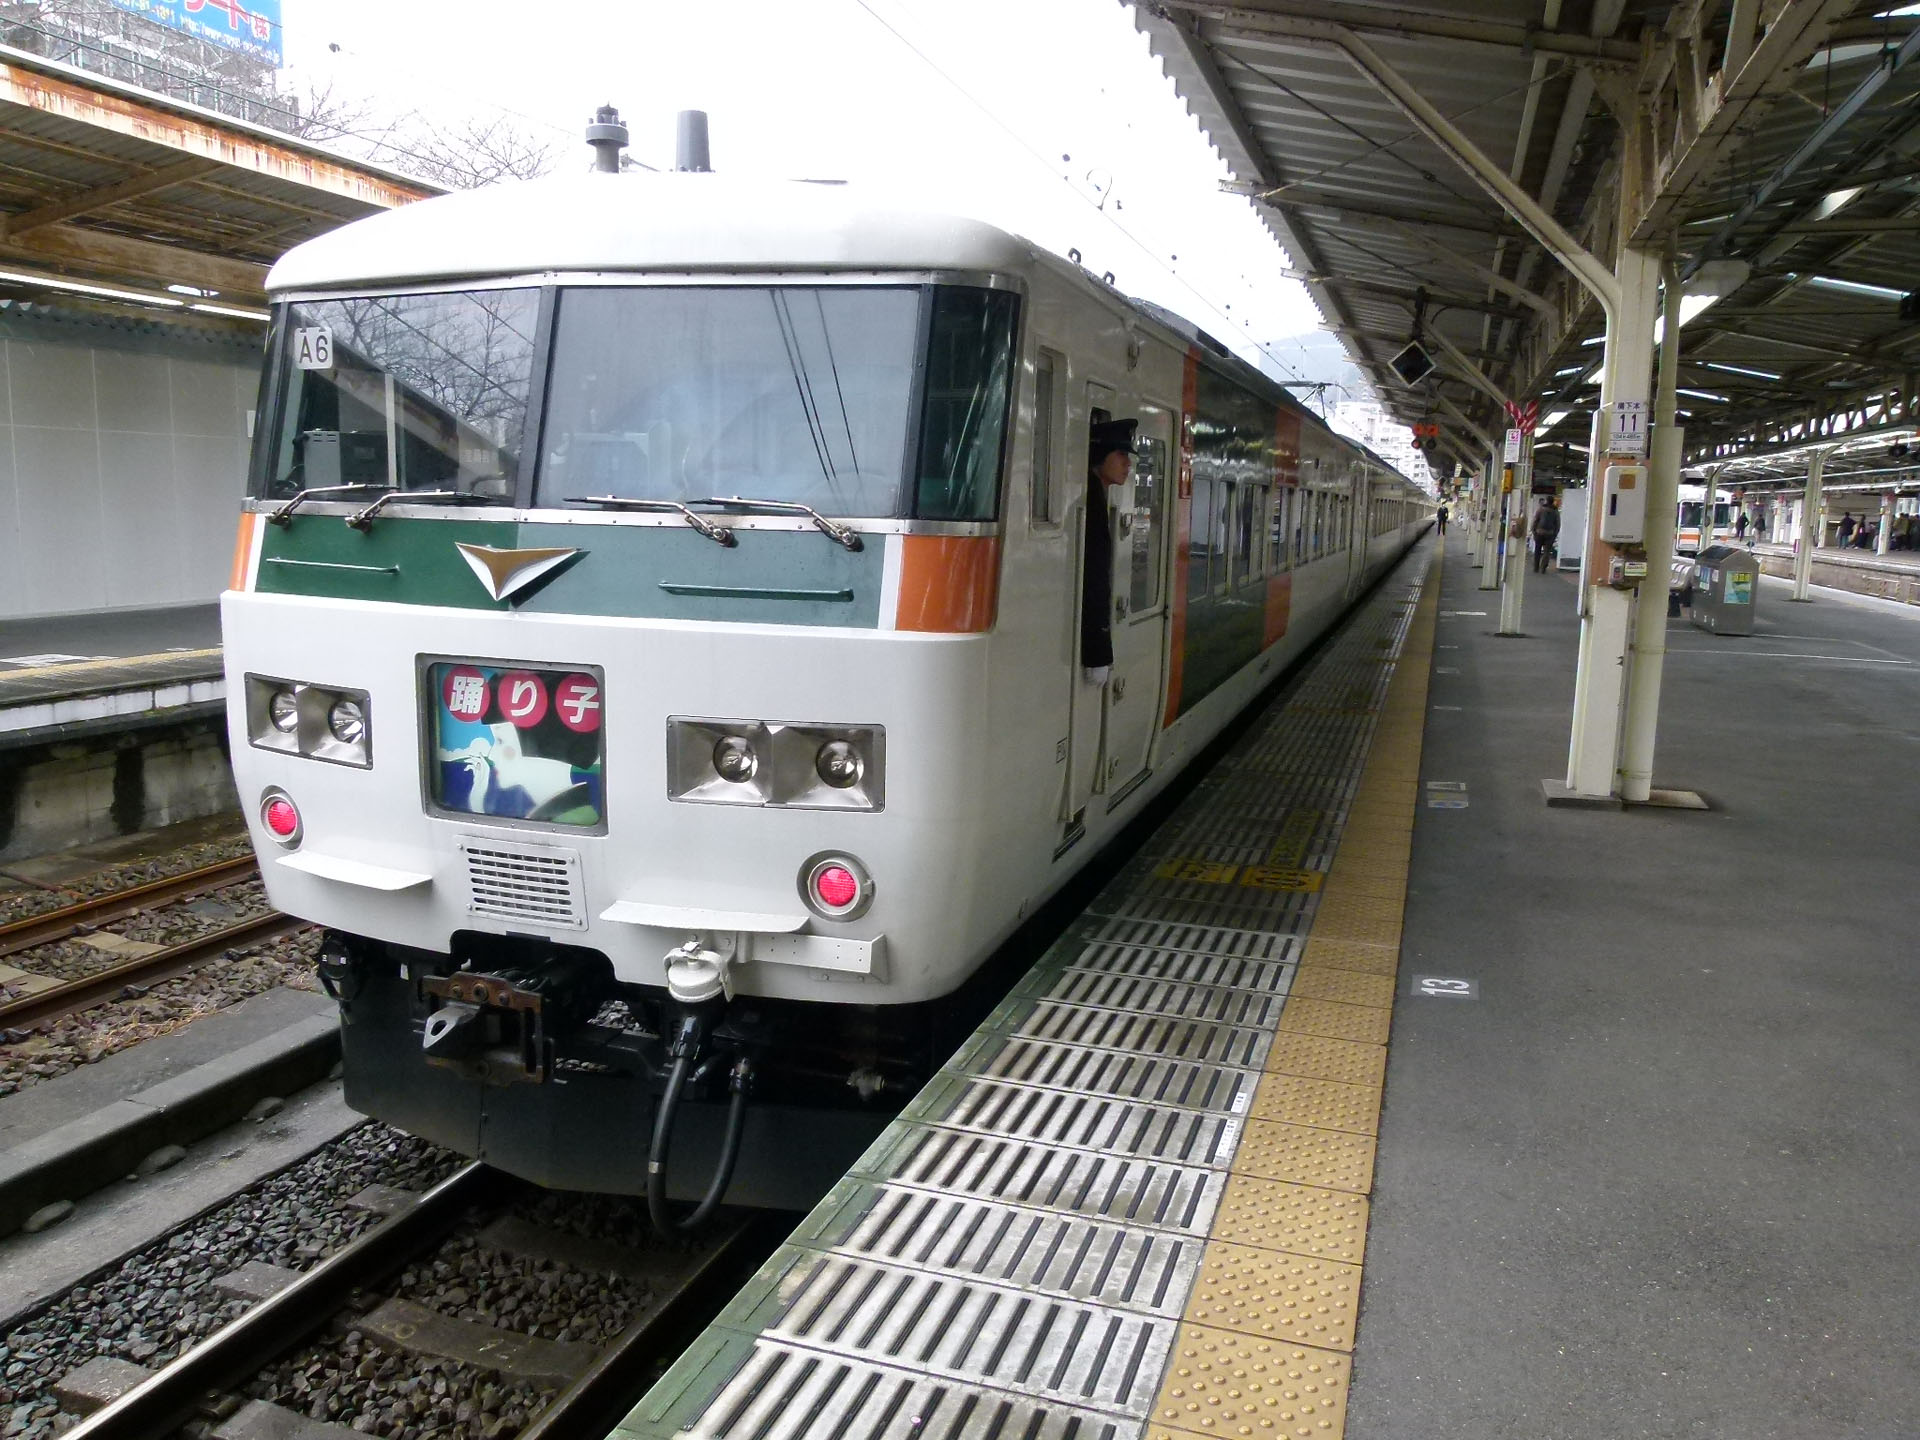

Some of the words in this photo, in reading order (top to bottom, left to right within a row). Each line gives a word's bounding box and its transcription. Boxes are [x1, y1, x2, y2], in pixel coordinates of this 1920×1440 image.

[299, 334, 329, 363] A6
[1619, 413, 1637, 432] 11
[449, 675, 600, 724] 踊り子
[1421, 978, 1470, 995] 13
